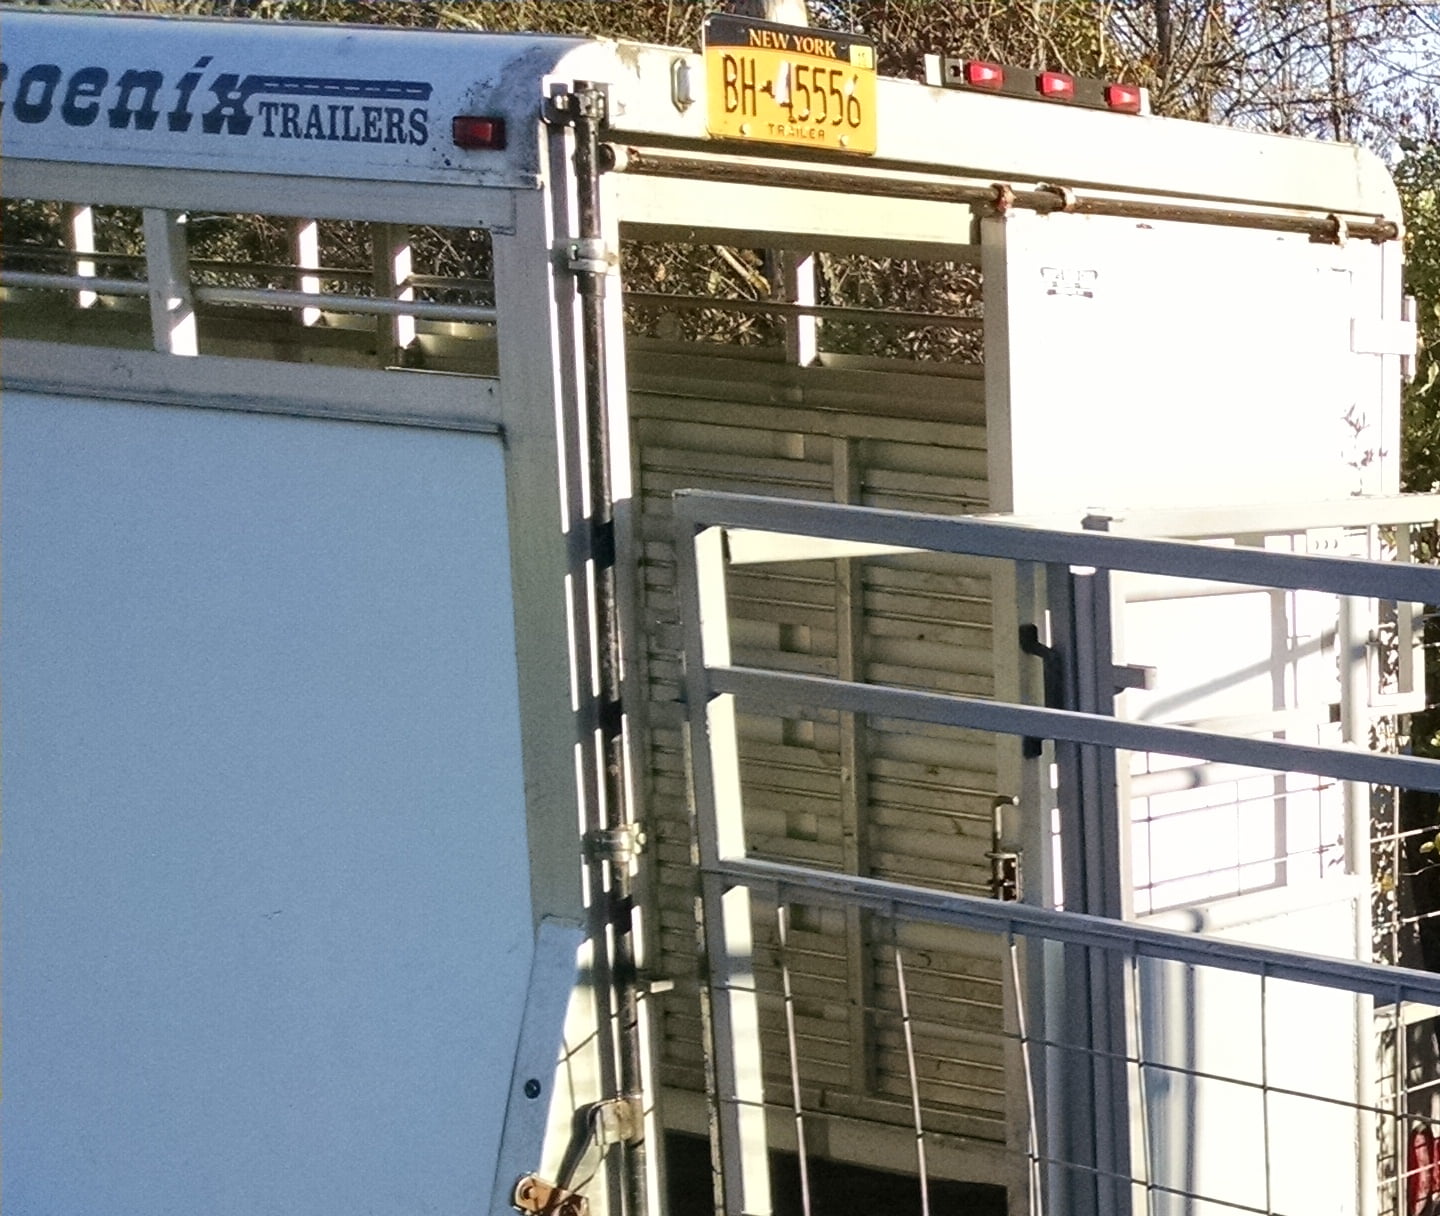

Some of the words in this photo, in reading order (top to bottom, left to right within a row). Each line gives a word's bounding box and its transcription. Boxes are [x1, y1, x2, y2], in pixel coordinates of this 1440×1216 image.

[749, 28, 789, 49] NEW
[793, 35, 836, 58] YORK
[0, 56, 255, 135] oenix
[257, 100, 429, 146] TRAILERS
[723, 54, 757, 117] BH
[767, 123, 825, 140] TRAILER
